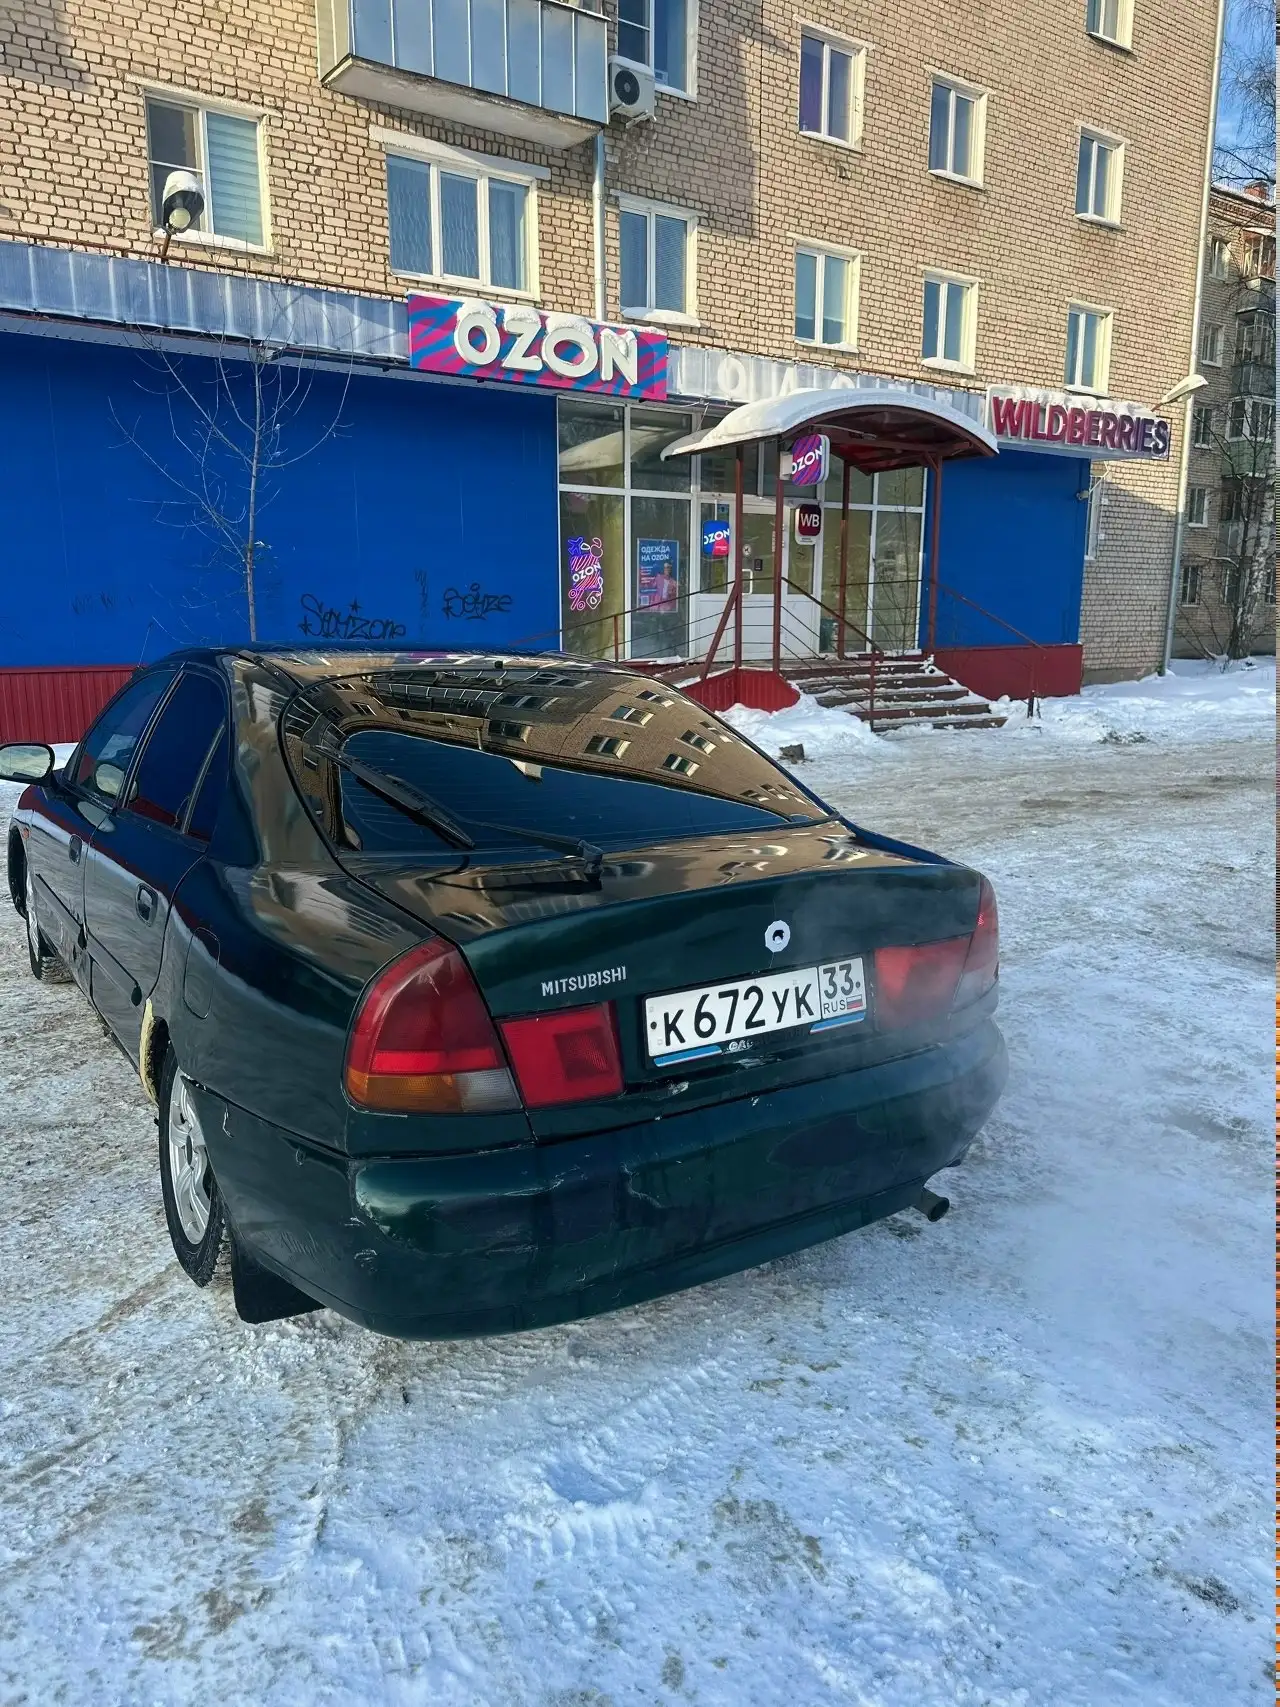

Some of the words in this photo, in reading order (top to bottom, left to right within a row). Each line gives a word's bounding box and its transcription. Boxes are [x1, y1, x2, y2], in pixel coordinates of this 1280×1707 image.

[453, 310, 638, 387] OZON
[991, 396, 1170, 456] WILDBERRIES
[791, 445, 823, 475] OZON
[800, 513, 820, 528] WB
[640, 545, 670, 554] ОДЕЖДА
[572, 562, 602, 582] OZON
[541, 965, 627, 997] MITSUBISHI
[663, 982, 815, 1047] К672УК
[822, 963, 853, 1000] 33
[823, 998, 846, 1015] RUS
